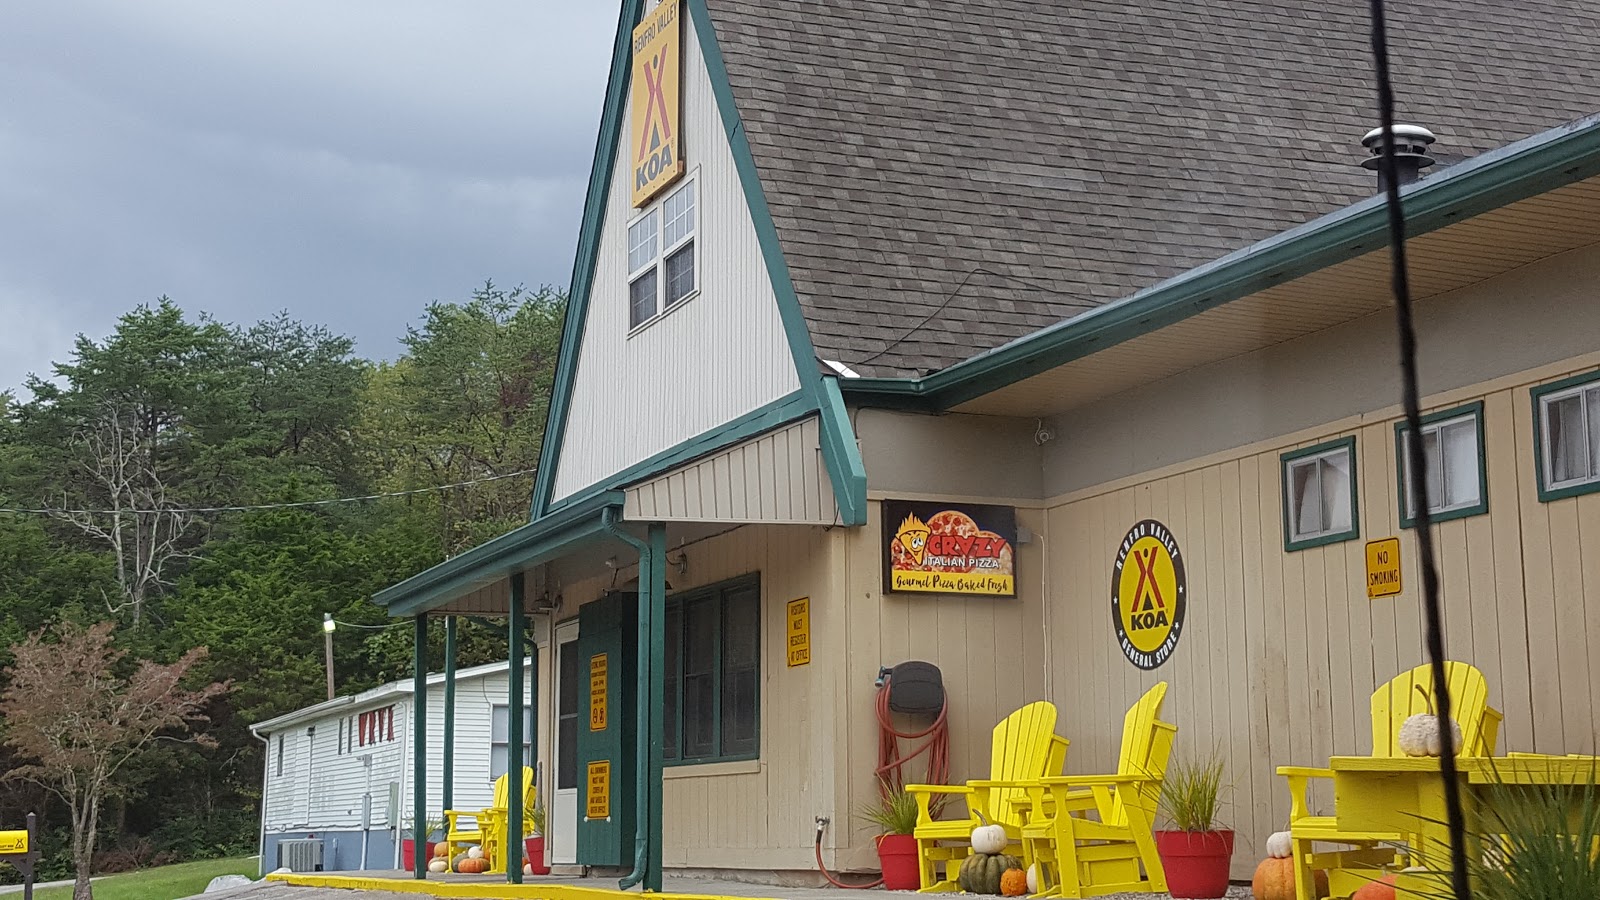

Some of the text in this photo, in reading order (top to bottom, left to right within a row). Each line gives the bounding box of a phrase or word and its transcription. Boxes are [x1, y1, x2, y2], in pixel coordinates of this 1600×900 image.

[634, 2, 676, 55] RENFRO VALLEY
[636, 144, 672, 192] KOA
[1116, 523, 1178, 570] RENFRO VALLEY
[923, 556, 999, 568] ITALIAN PIZZA
[1377, 551, 1388, 565] NO
[896, 574, 1008, 593] Gourmet Pizza Baked Fresh
[1370, 569, 1398, 586] SMOKING
[1131, 610, 1169, 631] KOA
[1122, 631, 1177, 667] GENERAL STORE
